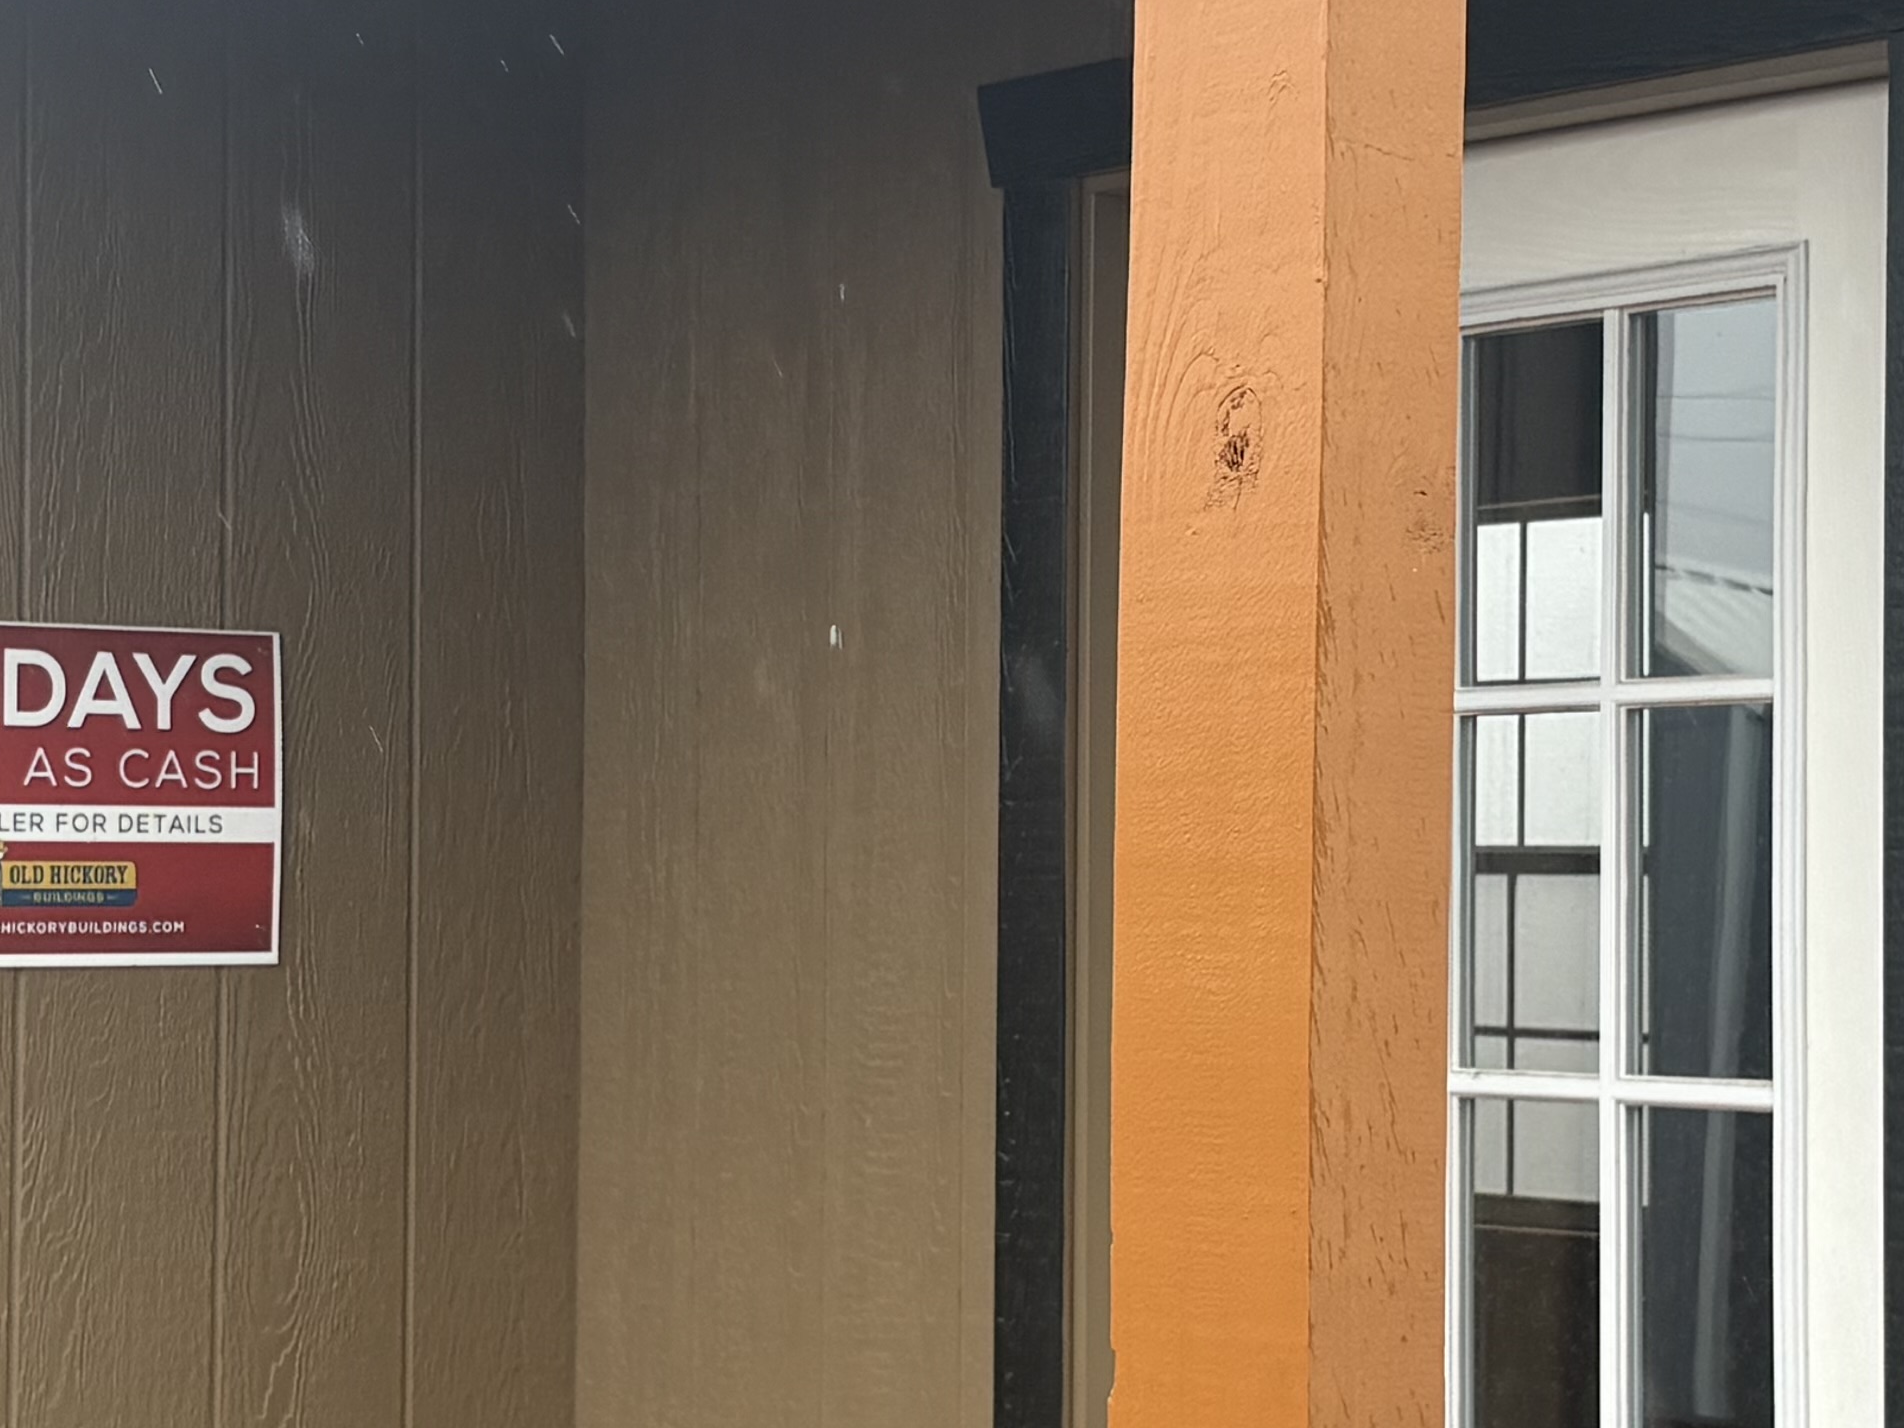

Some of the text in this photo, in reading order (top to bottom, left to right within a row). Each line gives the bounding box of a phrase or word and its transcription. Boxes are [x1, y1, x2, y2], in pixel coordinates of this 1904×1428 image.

[4, 648, 256, 733] DAYS
[23, 747, 93, 787] AS
[119, 750, 259, 790] CASH
[56, 813, 107, 834] FOR
[118, 814, 223, 834] DETAILS
[9, 865, 128, 884] OLD HICKORY
[33, 893, 104, 903] BUILDINGS
